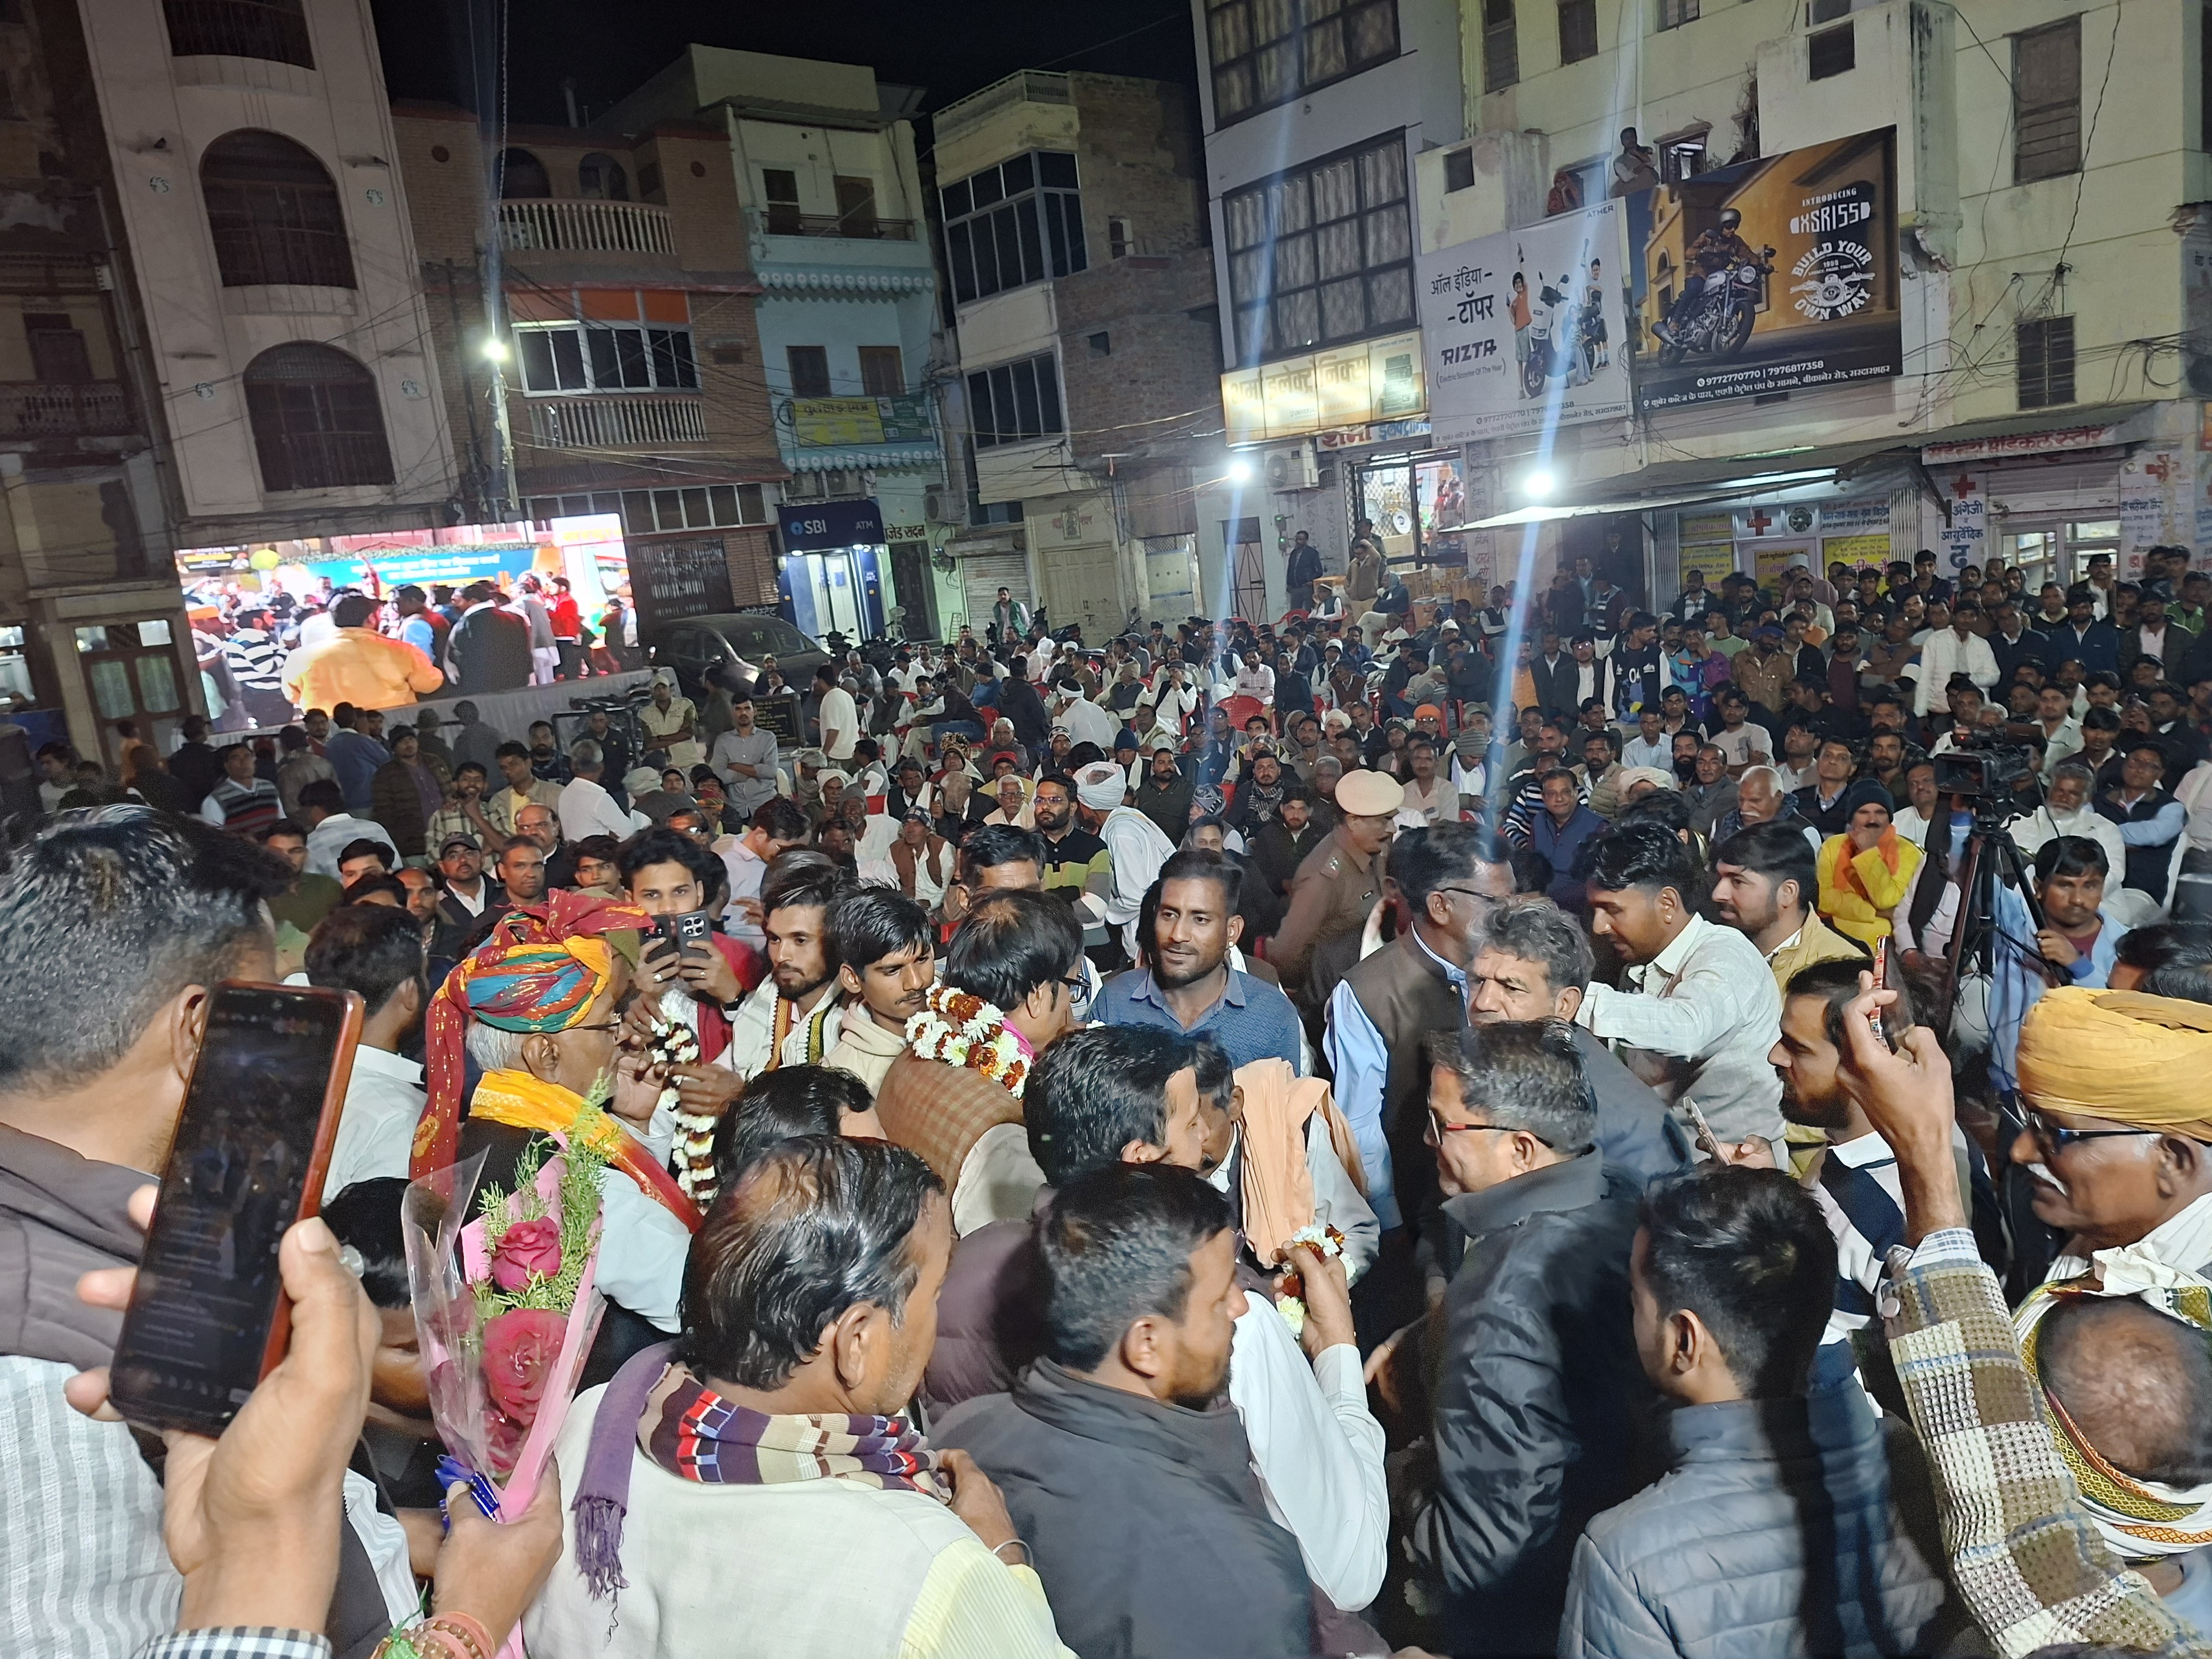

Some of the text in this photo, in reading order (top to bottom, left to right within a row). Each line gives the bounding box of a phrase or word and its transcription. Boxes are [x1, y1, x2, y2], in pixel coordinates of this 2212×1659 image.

[1802, 187, 1857, 207] INTRODUCING
[1586, 205, 1614, 218] ATHER
[1791, 240, 1872, 276] BUILD YOUR
[1431, 273, 1451, 296] ऑल
[1794, 288, 1871, 320] OWN WAY
[1441, 338, 1497, 366] RIZTA
[1706, 370, 1761, 385] 9772770770
[1767, 360, 1824, 376] 7976817358
[804, 520, 874, 535] SBI ATM
[904, 525, 926, 539] सदन
